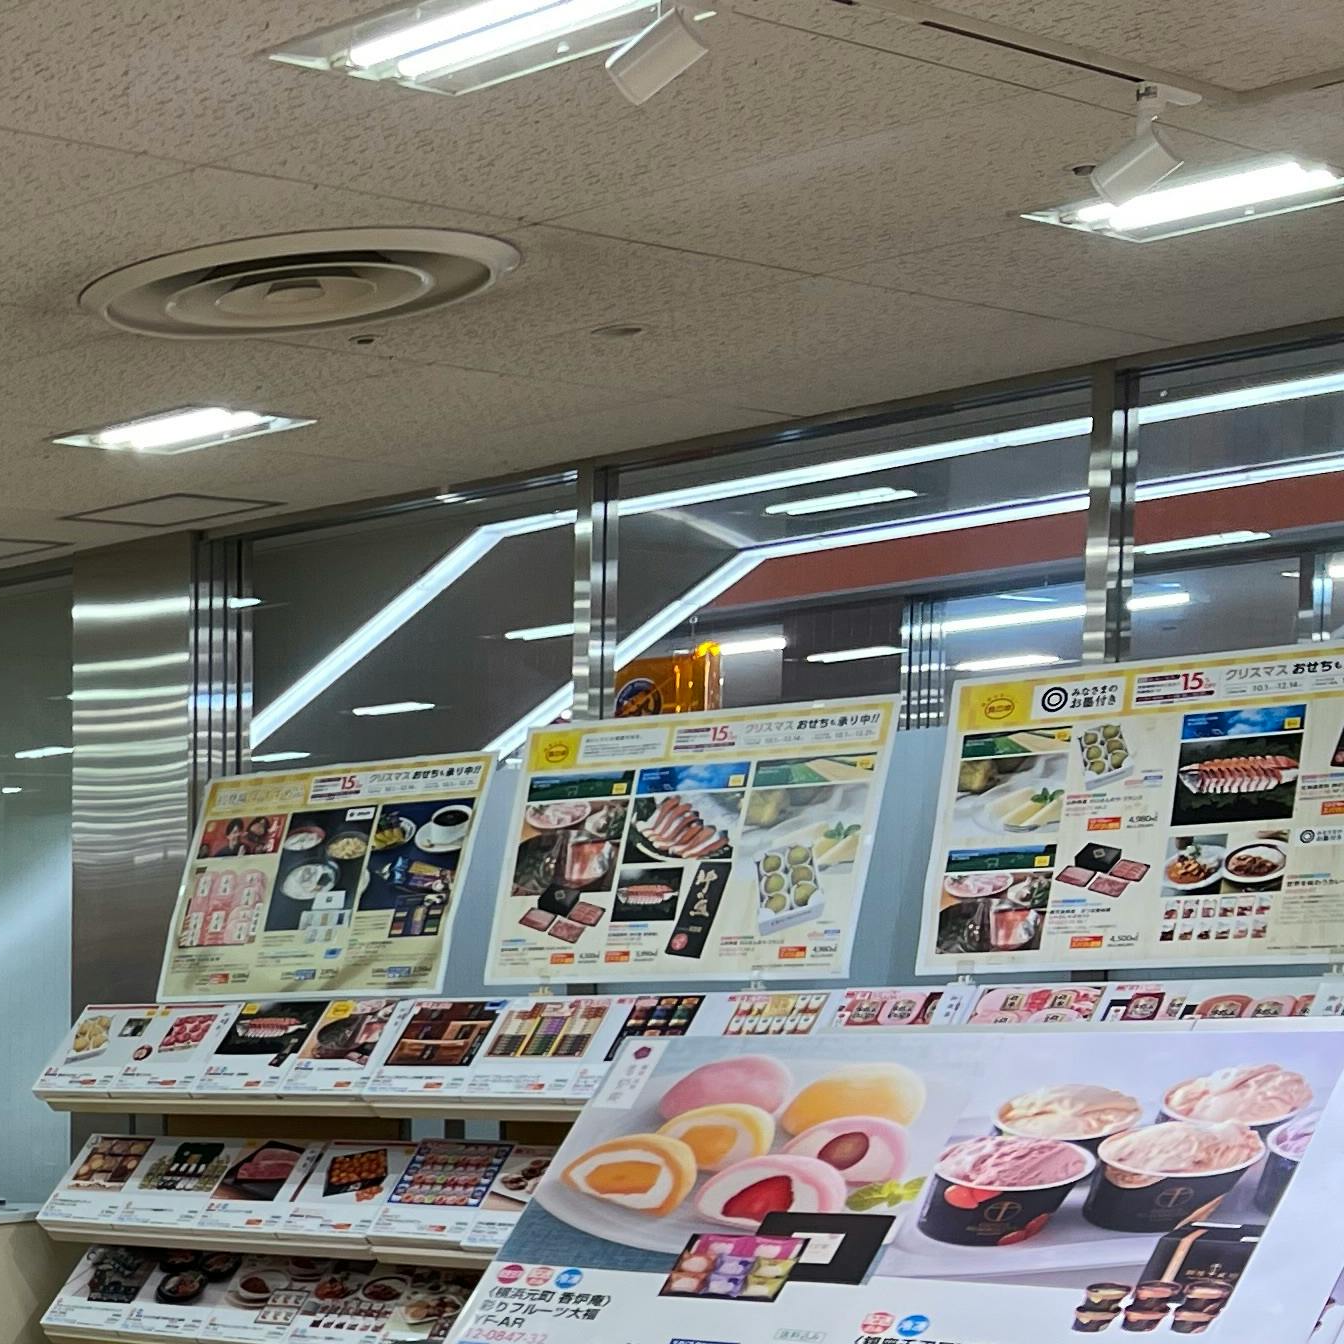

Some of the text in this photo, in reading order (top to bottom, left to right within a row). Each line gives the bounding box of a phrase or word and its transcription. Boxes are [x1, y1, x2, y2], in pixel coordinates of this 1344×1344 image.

[1182, 673, 1203, 691] 15
[710, 726, 729, 742] 15
[340, 775, 358, 790] 15
[480, 1300, 601, 1321] 彩りフルーツ大福
[464, 1327, 548, 1344] 12-0847-32
